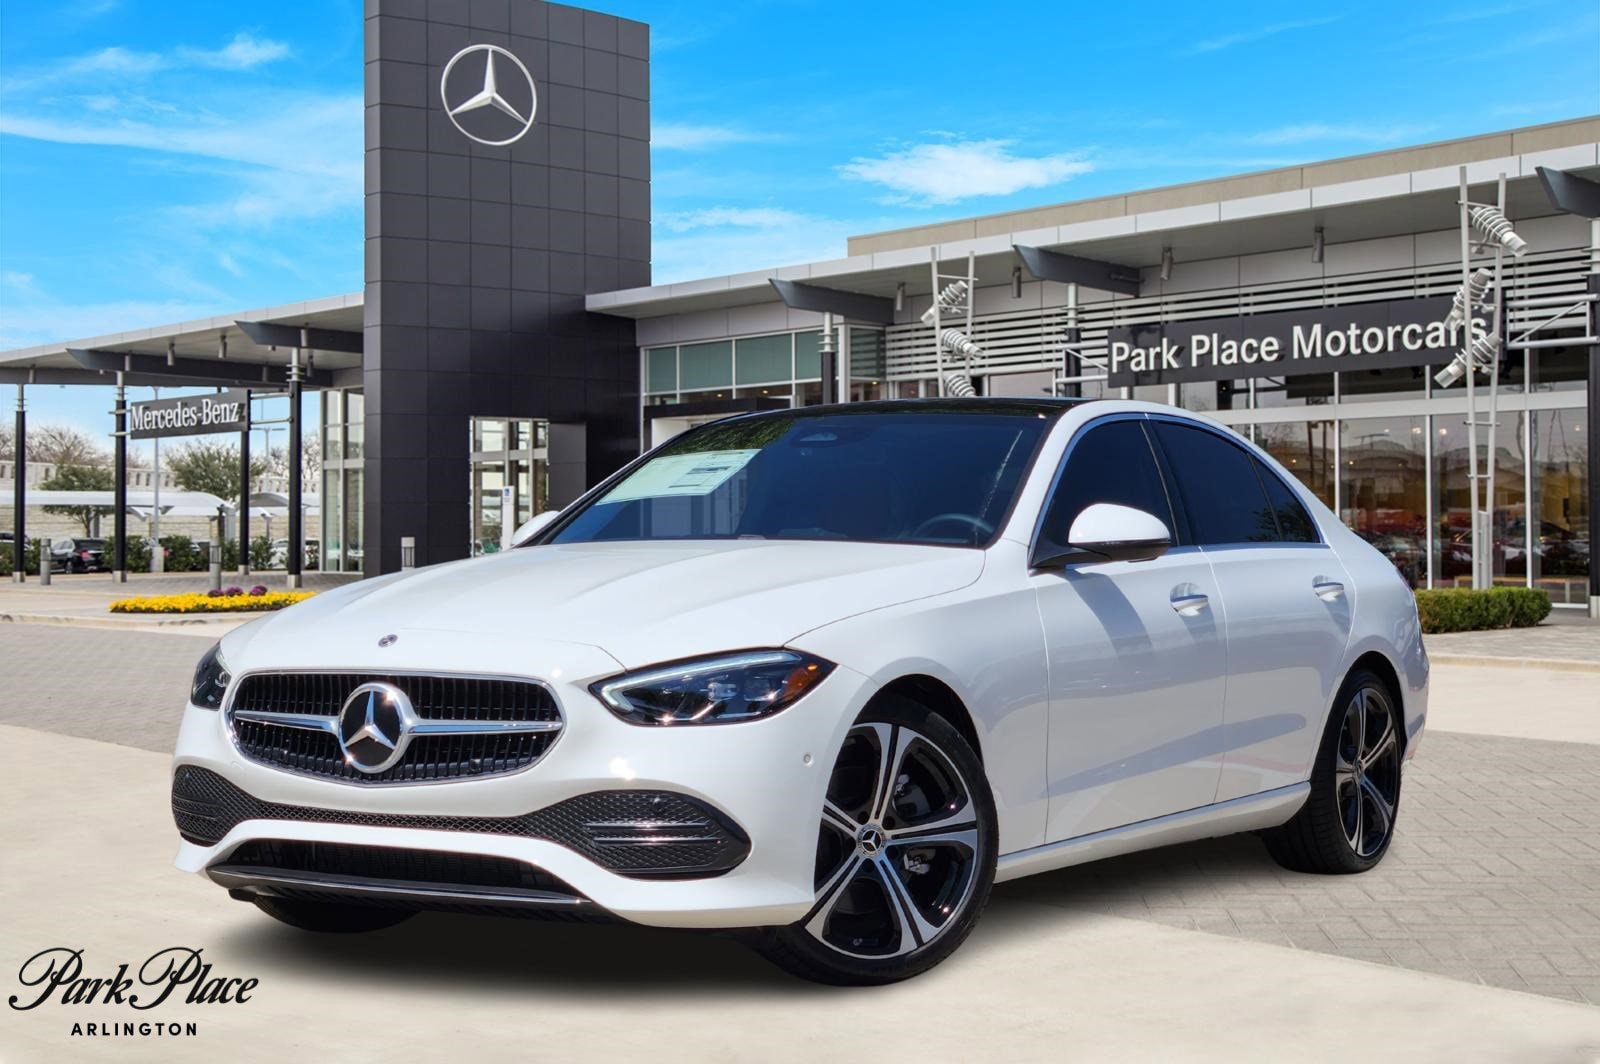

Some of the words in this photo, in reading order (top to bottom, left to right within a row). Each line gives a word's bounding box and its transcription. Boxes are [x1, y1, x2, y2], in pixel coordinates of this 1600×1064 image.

[1112, 337, 1180, 373] Park
[1191, 333, 1280, 367] Place
[131, 398, 239, 431] Mercedes-Benz
